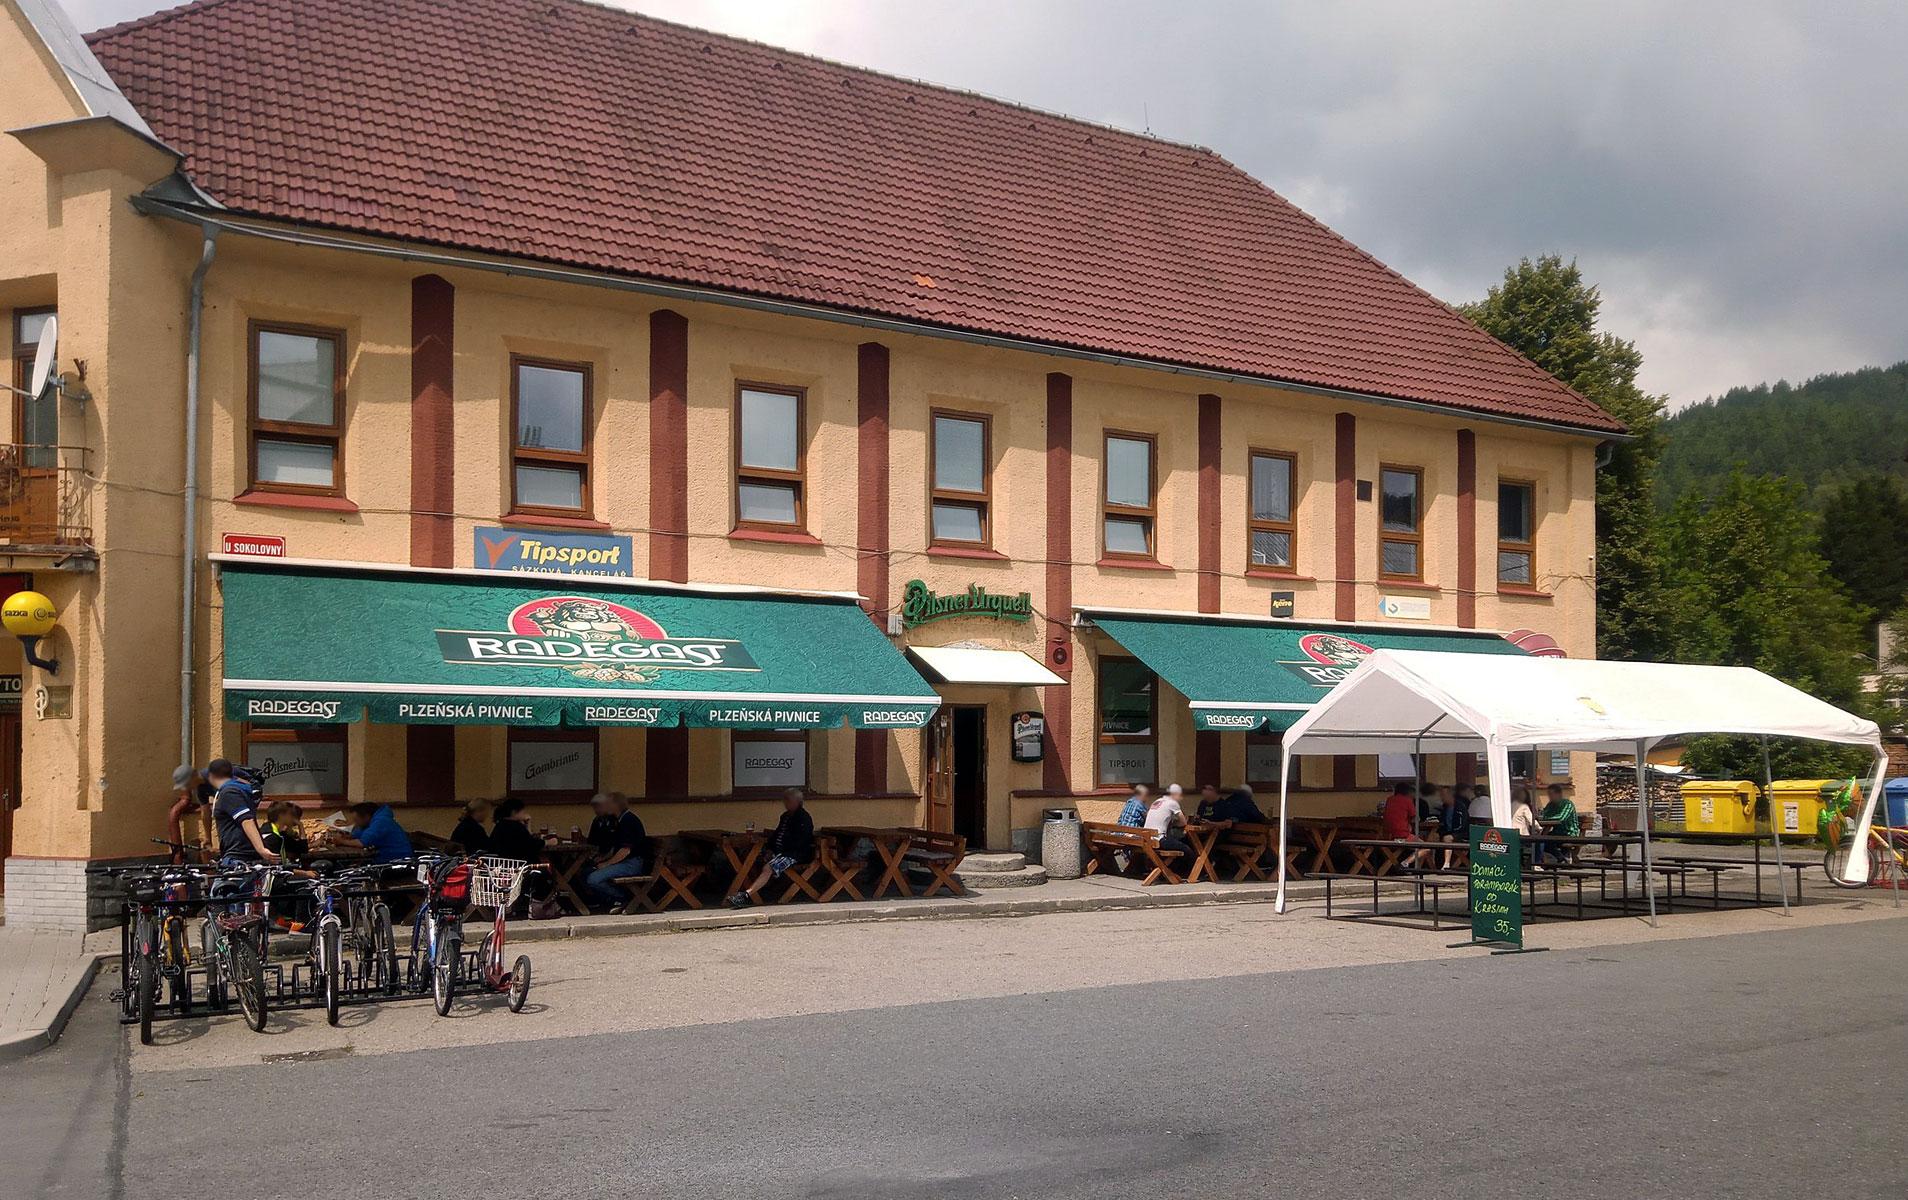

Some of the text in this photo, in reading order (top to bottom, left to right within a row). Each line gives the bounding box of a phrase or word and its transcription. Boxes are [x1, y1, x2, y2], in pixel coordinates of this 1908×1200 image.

[225, 542, 282, 555] U SOKOLOVNY
[520, 540, 621, 565] Tipsport
[903, 579, 1032, 627] Pilsner Urquell
[467, 637, 727, 667] RADEGAST
[0, 678, 21, 691] TO
[249, 700, 341, 718] RADEGAST
[400, 702, 533, 718] PLZEŇSKÁ PIVNICE
[585, 706, 662, 723] RADEGAST
[709, 708, 820, 722] PLZEŇSKÁ PIVNICE
[863, 711, 926, 725] RADEGAST
[1206, 715, 1255, 727] RADEGAST
[525, 752, 580, 779] Gambrinus
[745, 758, 794, 769] RADEGAST
[1109, 760, 1146, 768] TIPSPORT
